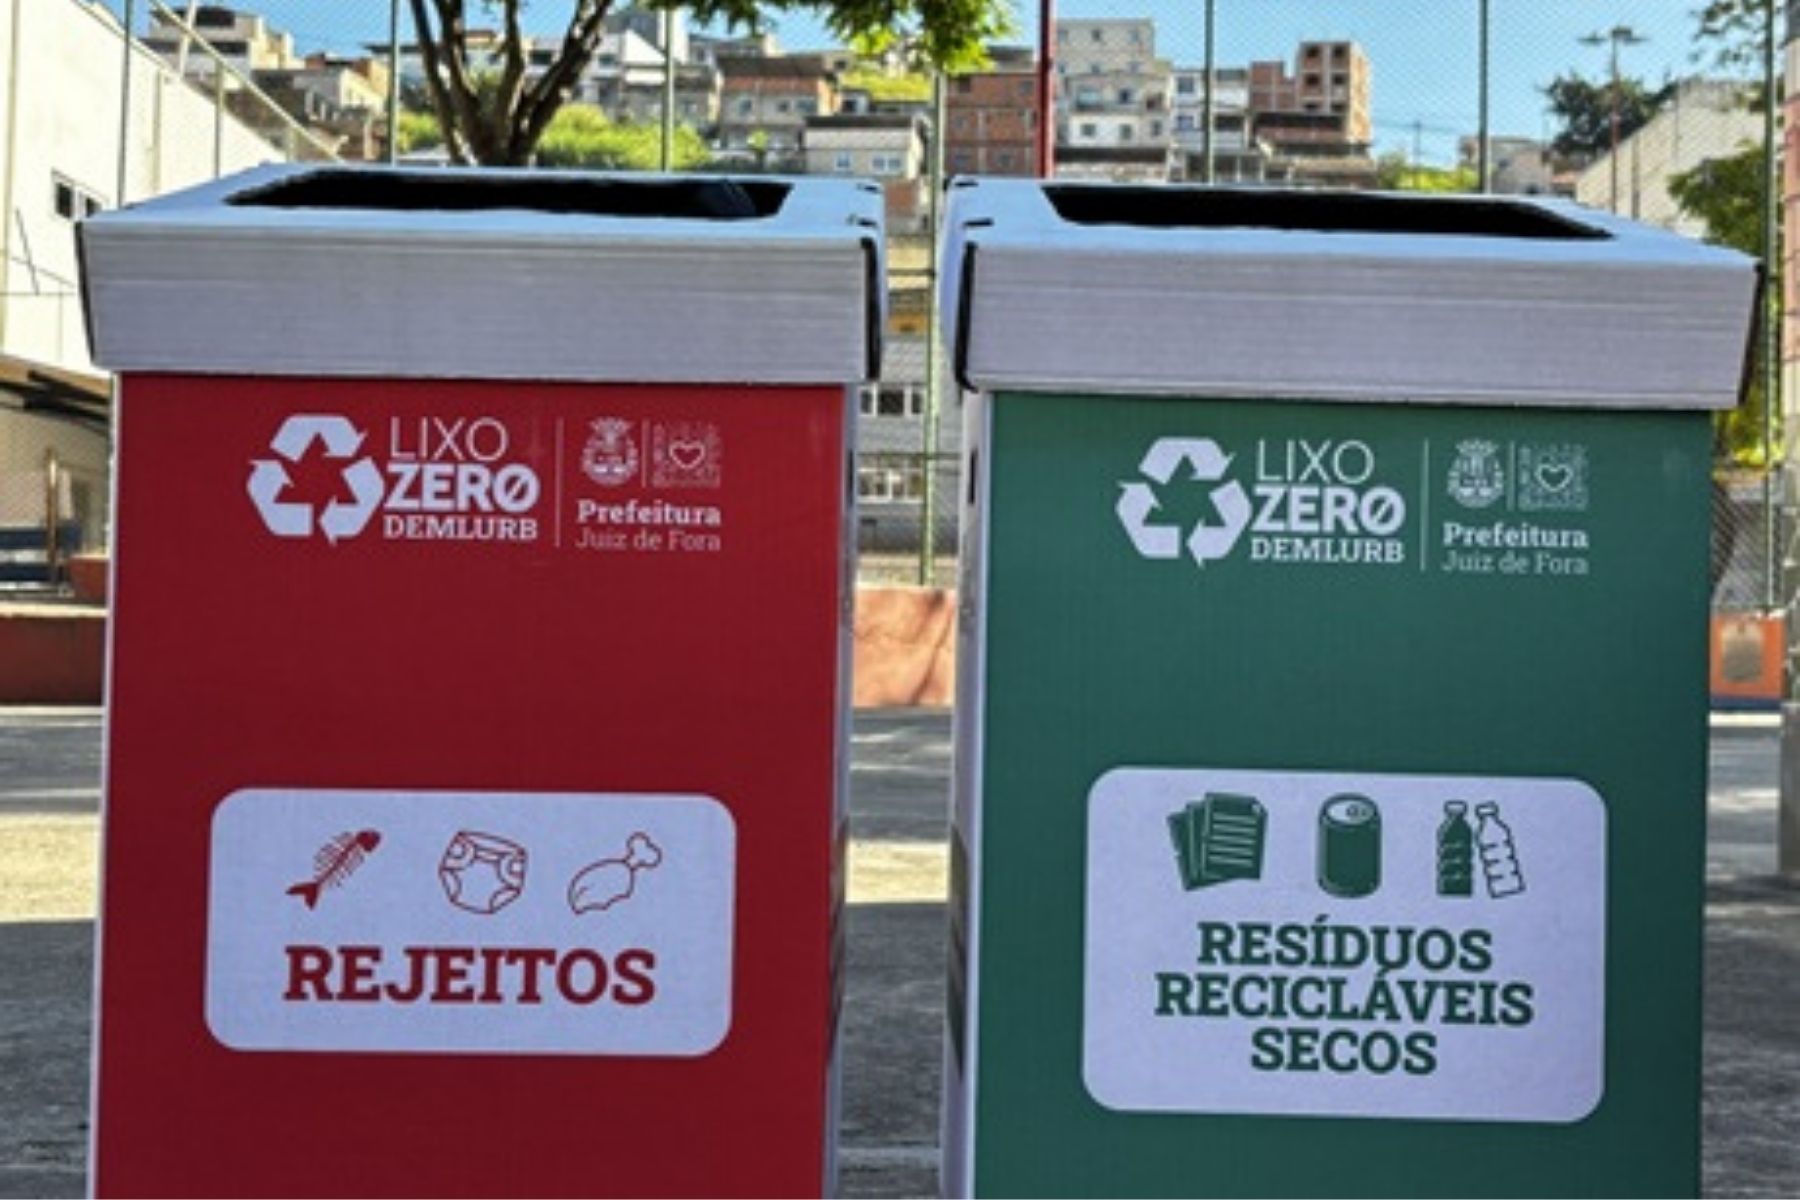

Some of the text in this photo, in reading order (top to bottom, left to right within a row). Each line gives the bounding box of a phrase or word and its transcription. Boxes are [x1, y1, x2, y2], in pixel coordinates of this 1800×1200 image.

[389, 416, 509, 462] LIXO
[1257, 438, 1375, 484] LIXO
[384, 515, 538, 541] DEMLURB
[576, 498, 722, 526] Prefeitura
[575, 527, 721, 552] Juiz de Fora
[1251, 537, 1405, 564] DEMLURB
[1442, 521, 1589, 549] Prefeitura
[1441, 549, 1589, 575] Juiz de Fora
[1197, 914, 1493, 972] RESÍDUOS
[284, 945, 656, 1005] REJEITOS
[1154, 966, 1535, 1026] RECICLÁVEIS
[1251, 1027, 1437, 1076] SECOS
